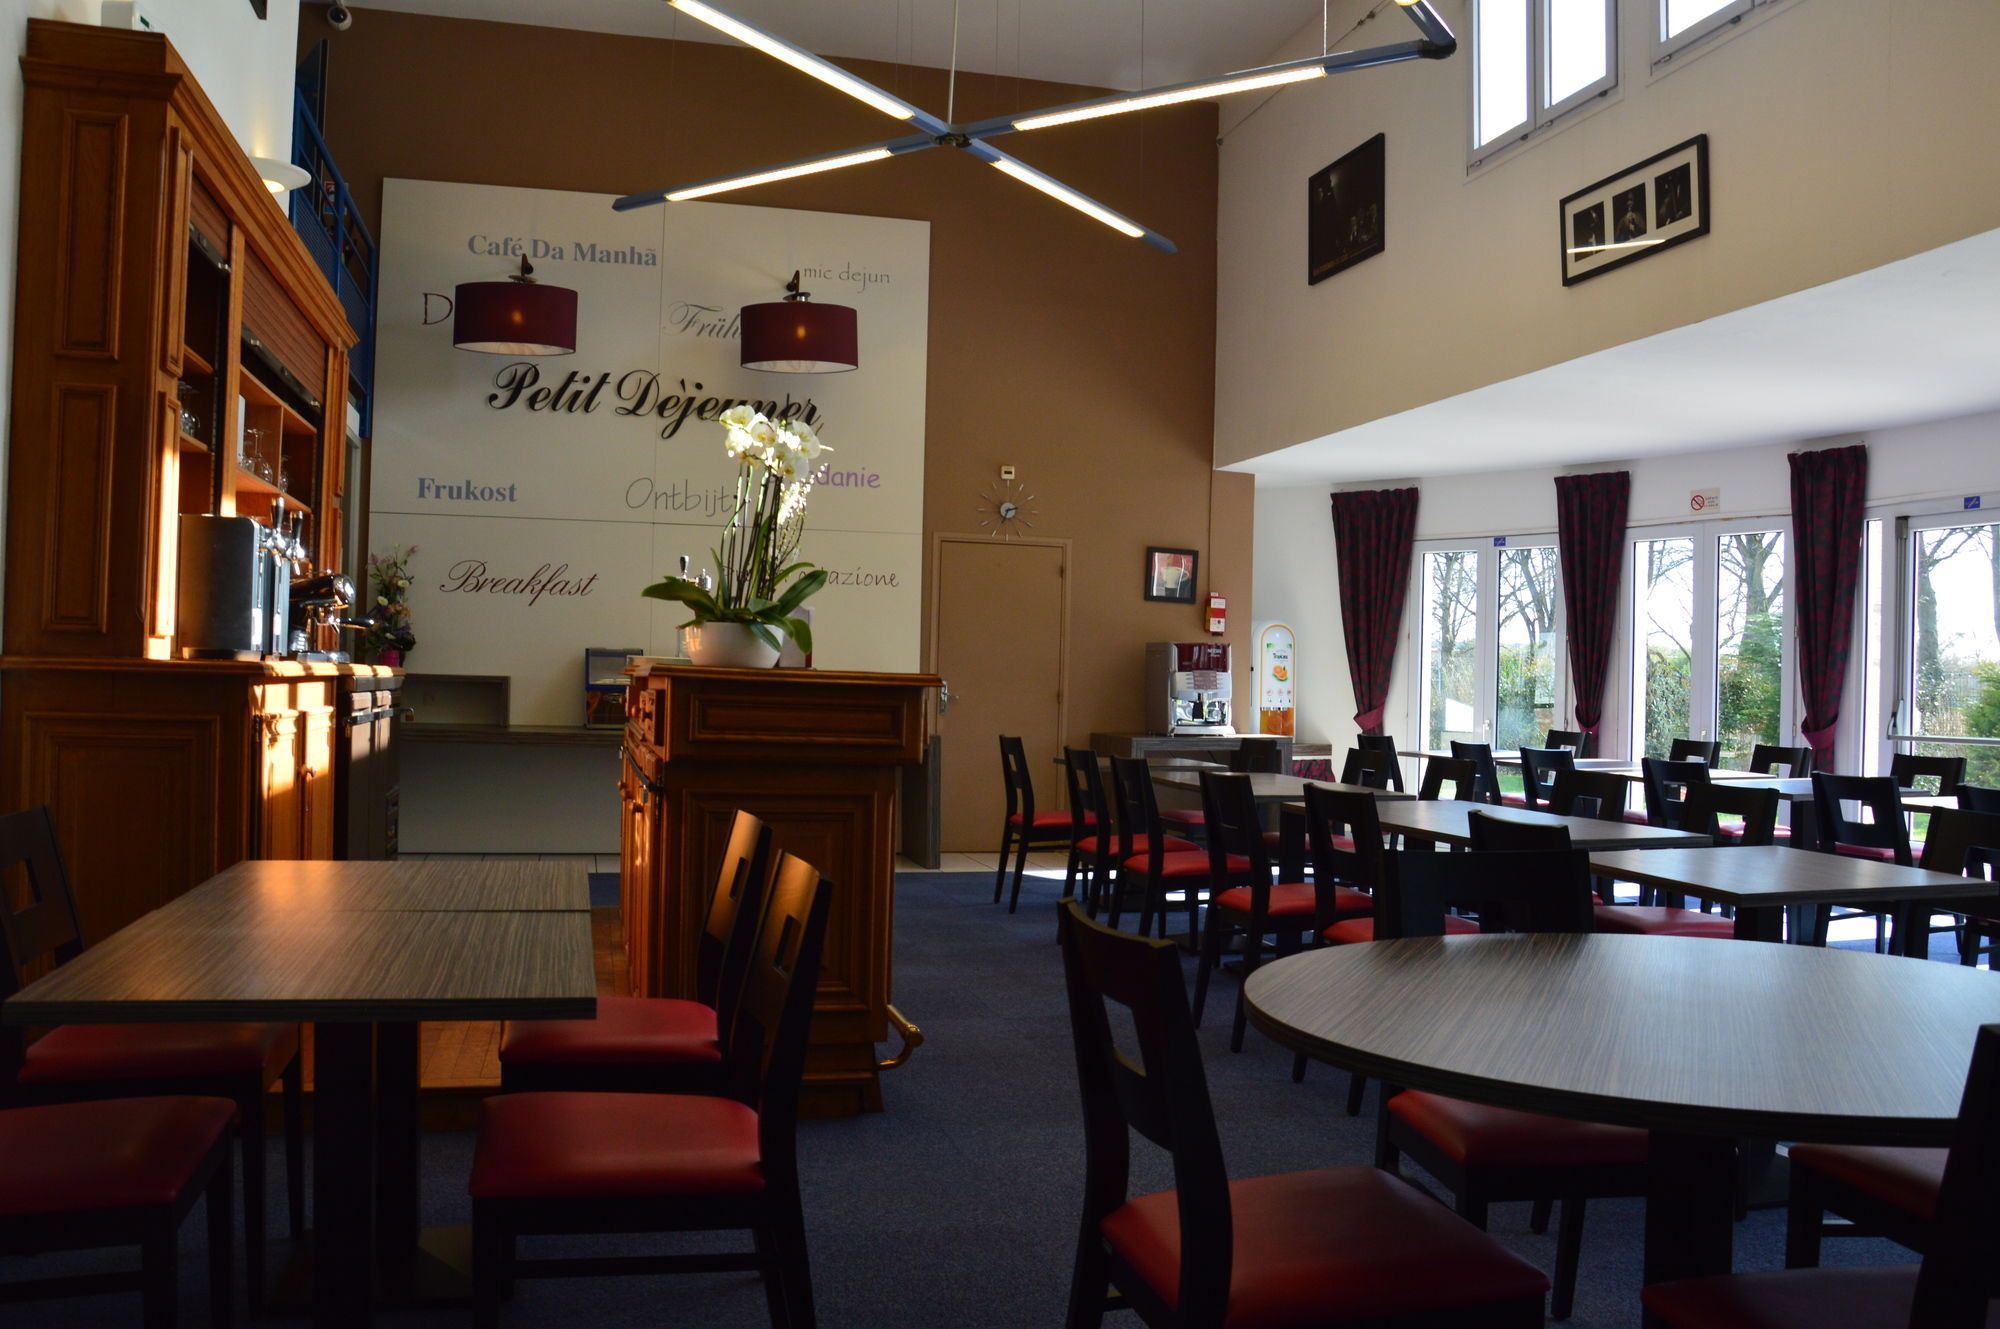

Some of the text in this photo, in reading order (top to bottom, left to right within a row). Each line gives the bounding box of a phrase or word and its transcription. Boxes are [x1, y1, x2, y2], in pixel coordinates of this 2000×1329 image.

[467, 234, 657, 266] Café Da Manhã
[803, 261, 890, 294] mic dejun
[422, 292, 454, 326] D
[663, 302, 741, 339] Früh
[488, 362, 611, 413] Petit
[416, 476, 518, 502] Frukost
[625, 477, 733, 517] Ontbijt
[439, 559, 599, 607] Breakfast
